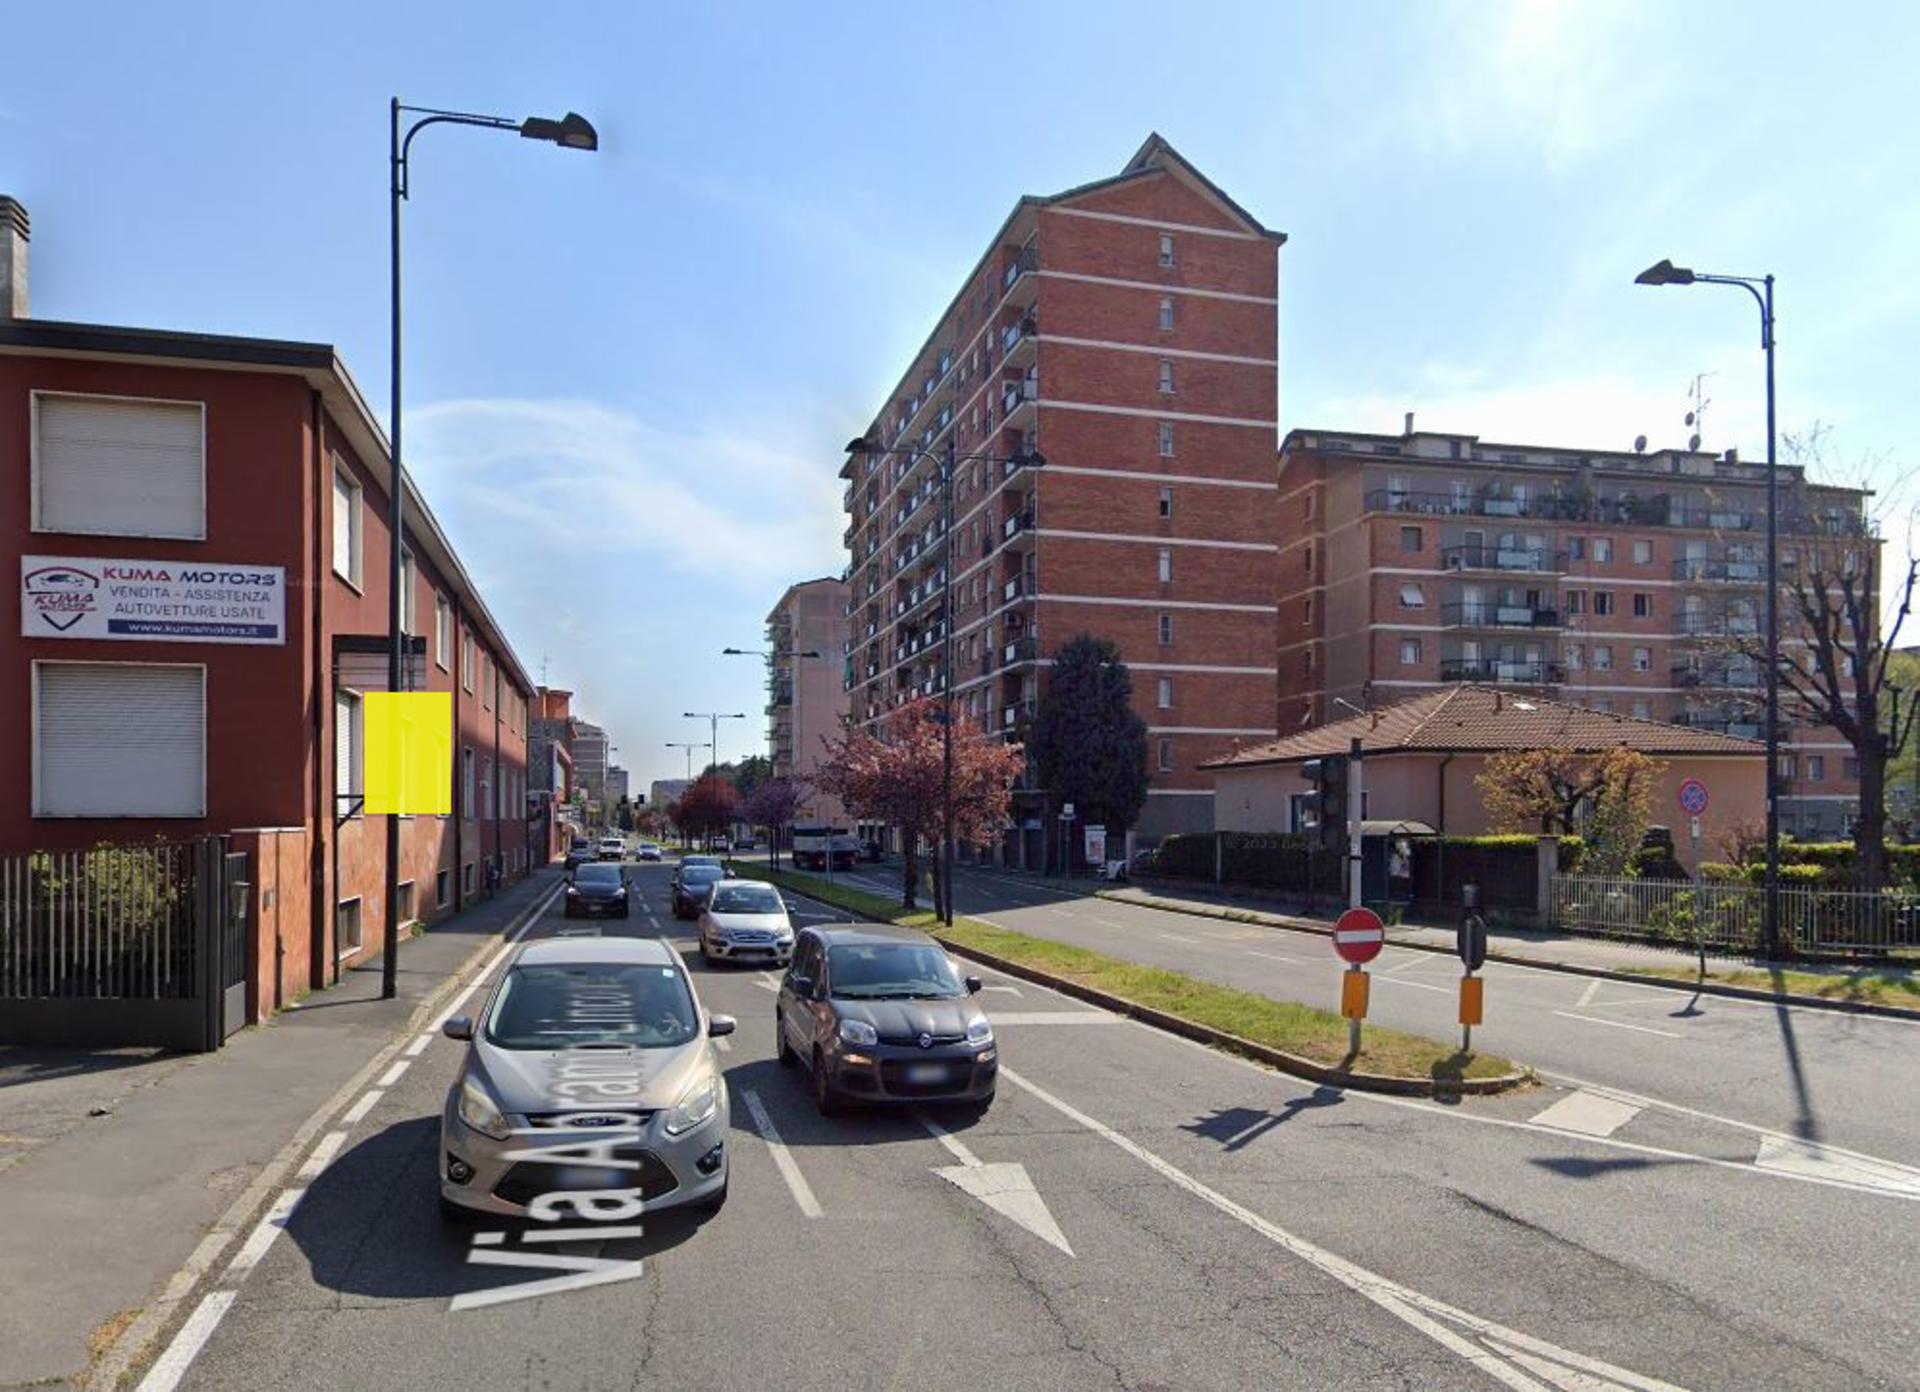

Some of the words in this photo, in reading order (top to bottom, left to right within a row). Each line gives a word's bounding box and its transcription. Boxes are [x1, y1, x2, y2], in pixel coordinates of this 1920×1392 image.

[103, 566, 171, 582] KUMA
[179, 571, 276, 586] MOTORS
[34, 593, 95, 605] KUMA
[110, 586, 170, 599] VENDITA
[184, 588, 270, 602] ASSISTENZA
[115, 603, 216, 618] AUTOVETTURE
[221, 606, 265, 619] USATE
[129, 623, 258, 635] www.kumamotors.it
